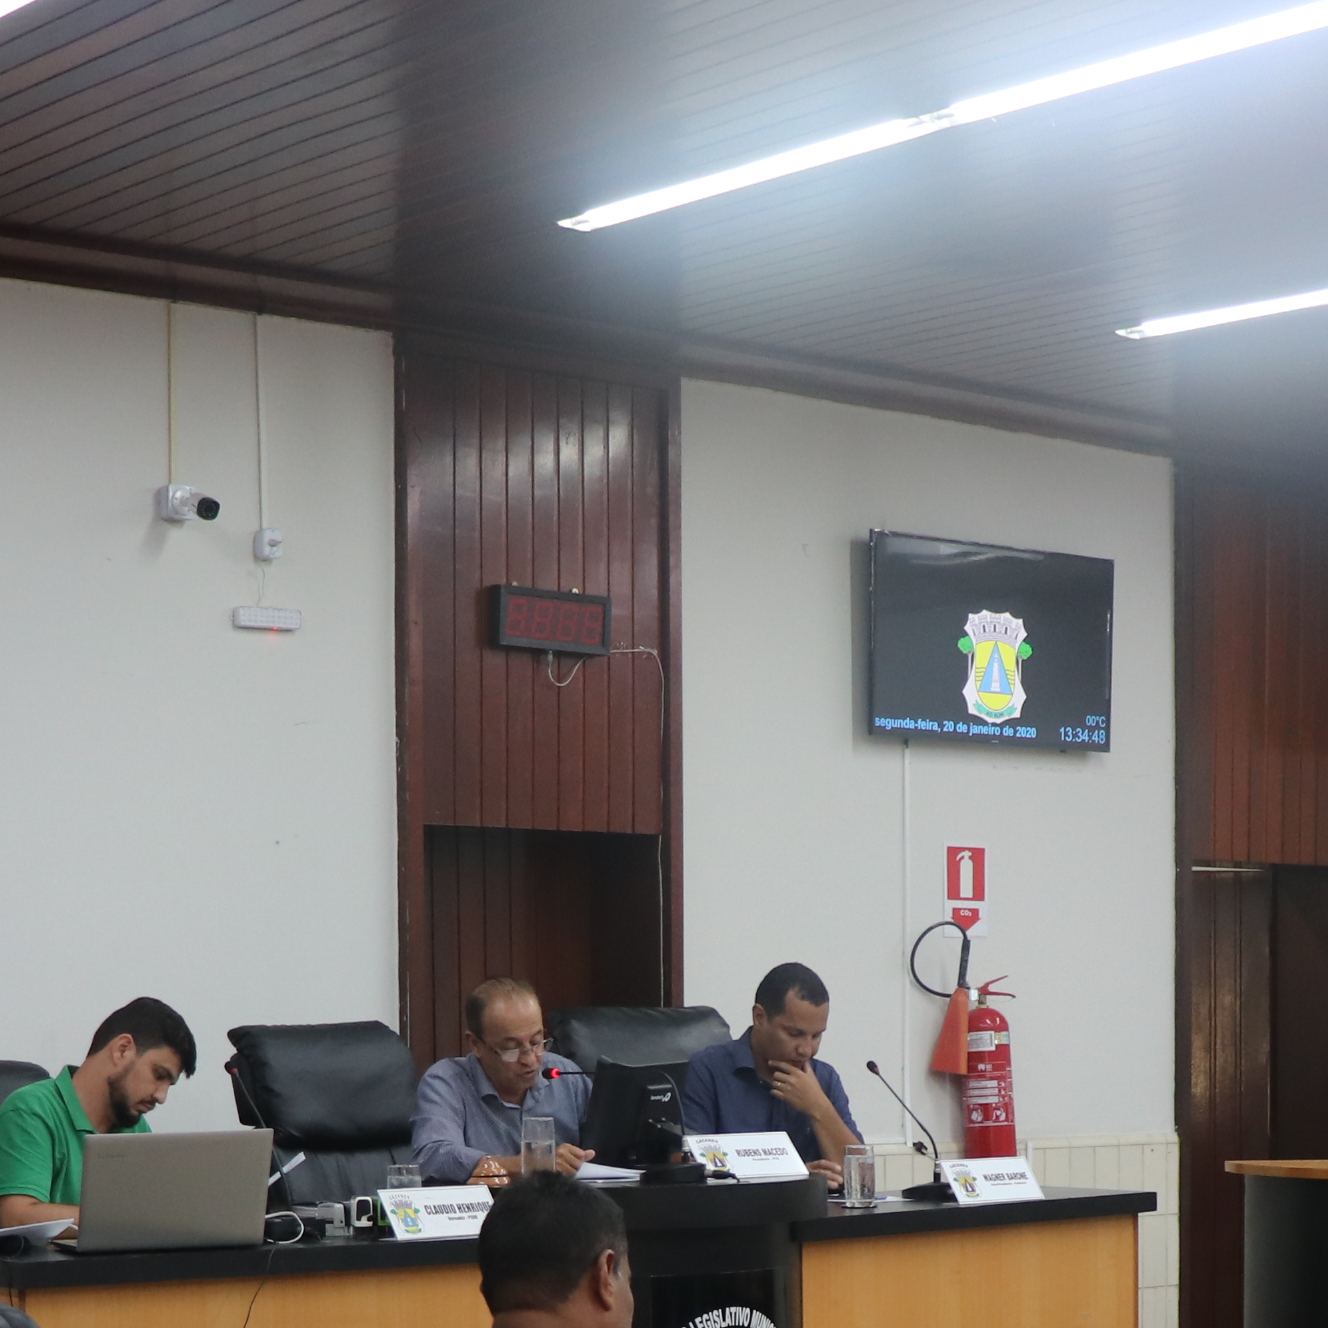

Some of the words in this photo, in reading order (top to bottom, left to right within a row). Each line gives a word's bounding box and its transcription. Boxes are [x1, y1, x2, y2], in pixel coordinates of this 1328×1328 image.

[875, 717, 941, 733] segunda-feira,
[943, 720, 954, 731] 20
[956, 721, 968, 733] de
[969, 722, 1001, 736] janeiro
[1002, 725, 1014, 736] de
[1015, 726, 1037, 738] 2020
[1059, 727, 1106, 744] 13:34:48
[735, 1148, 763, 1157] RUBENS
[763, 1147, 789, 1157] MACEDO
[982, 1173, 1007, 1182] WAGNER
[1007, 1171, 1028, 1181] BARONE
[424, 1203, 457, 1216] CLAUDIO
